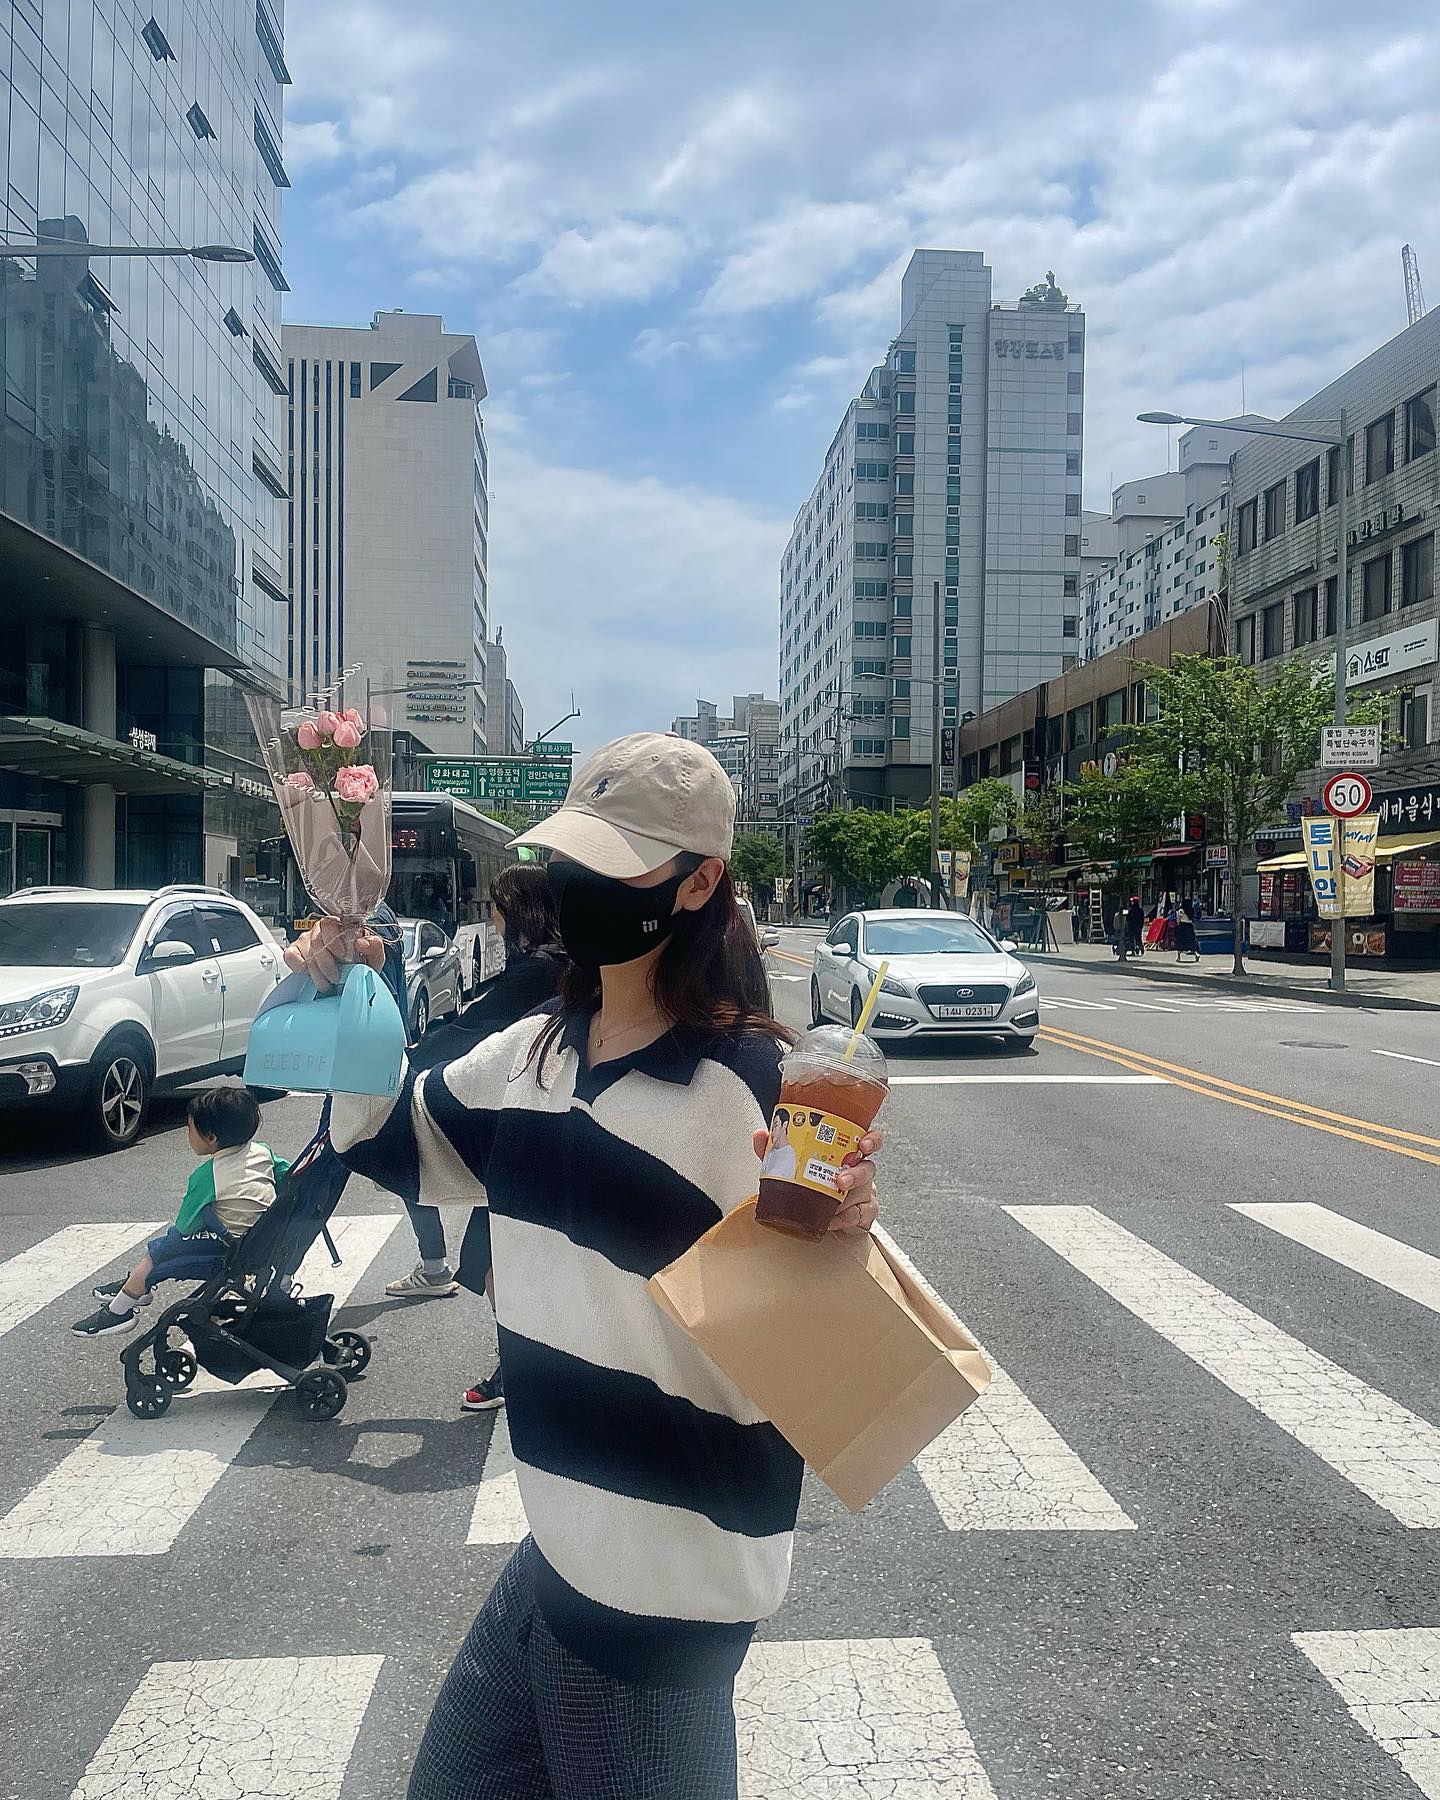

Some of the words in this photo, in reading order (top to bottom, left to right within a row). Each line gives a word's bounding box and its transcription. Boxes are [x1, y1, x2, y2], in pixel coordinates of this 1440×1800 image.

[1326, 738, 1376, 748] 특별단속구역
[432, 768, 470, 778] 양화대교
[488, 768, 520, 777] 영등포역
[527, 770, 569, 780] 경인고속도로
[488, 788, 515, 798] 당산역
[1333, 784, 1362, 807] 50
[965, 1006, 987, 1016] 0231
